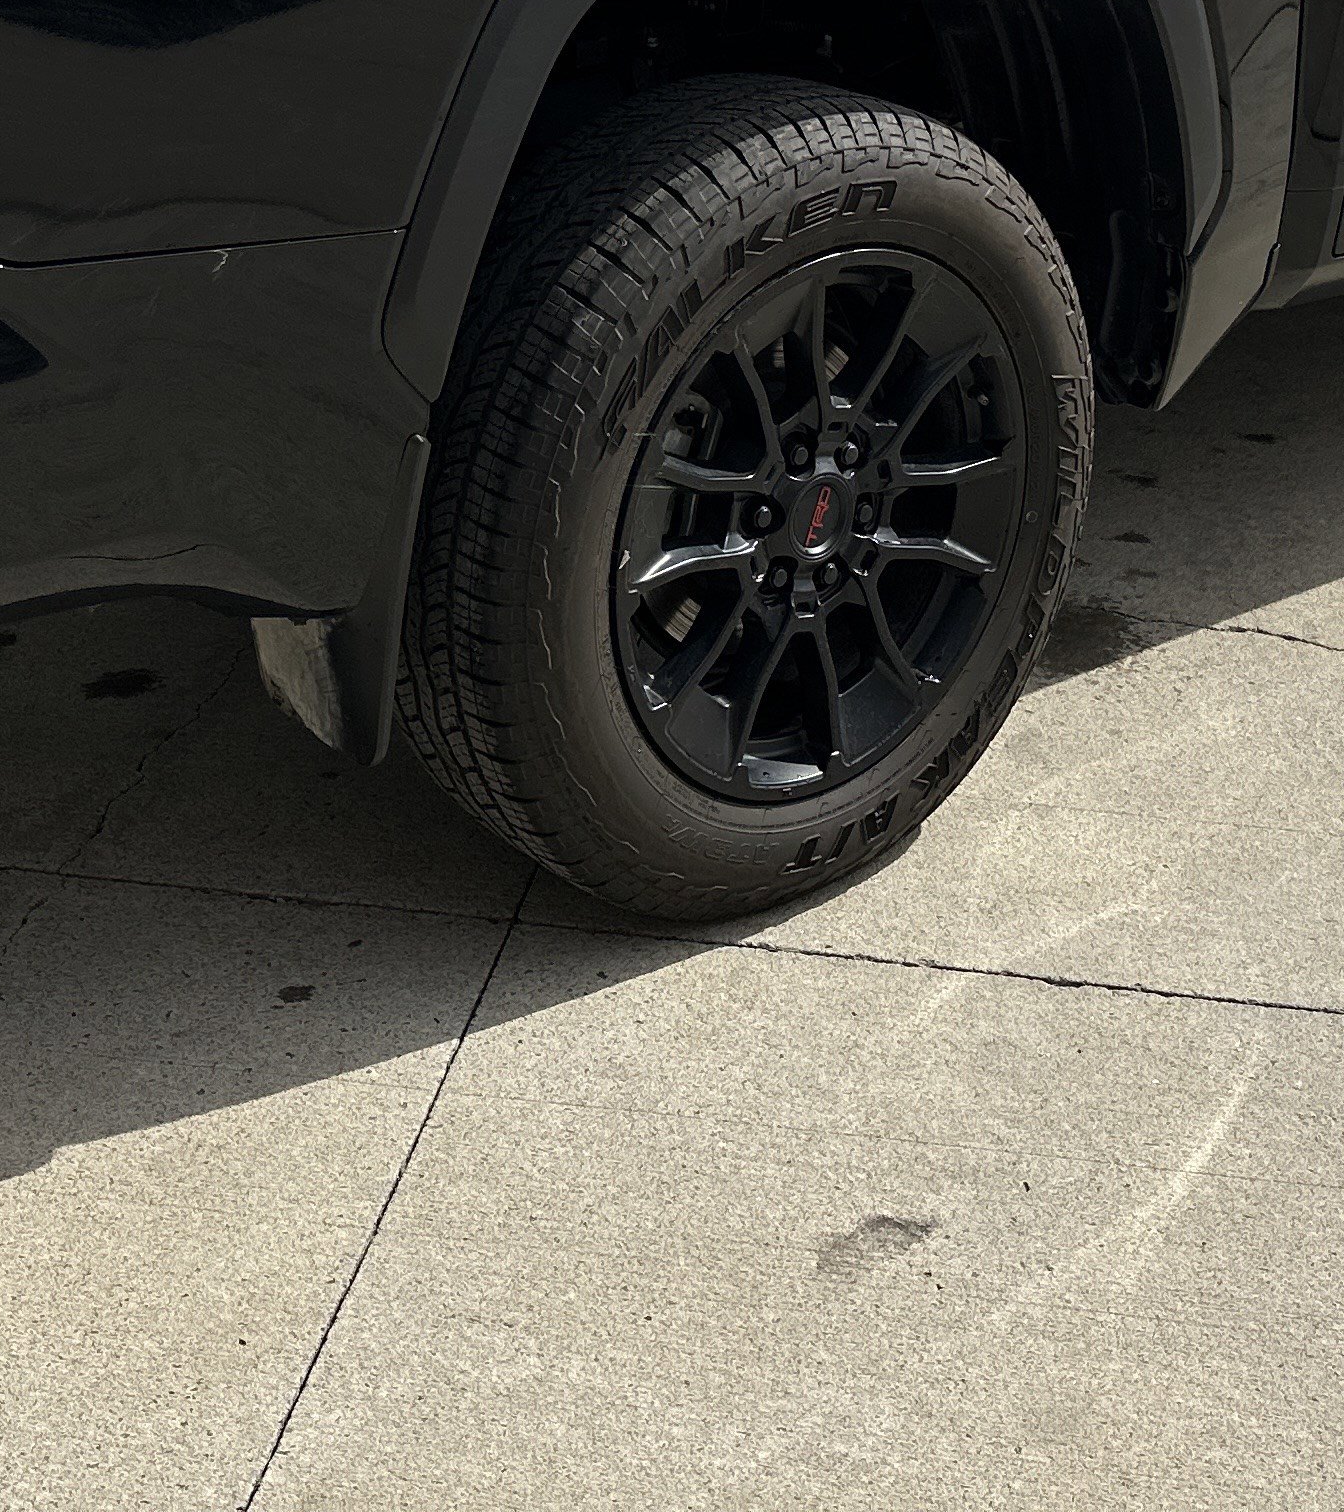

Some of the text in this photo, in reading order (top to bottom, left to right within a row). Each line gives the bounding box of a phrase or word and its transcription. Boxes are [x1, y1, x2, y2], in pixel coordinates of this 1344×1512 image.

[604, 179, 899, 456] FALKEN
[803, 486, 833, 547] TRD
[781, 792, 899, 876] A/T
